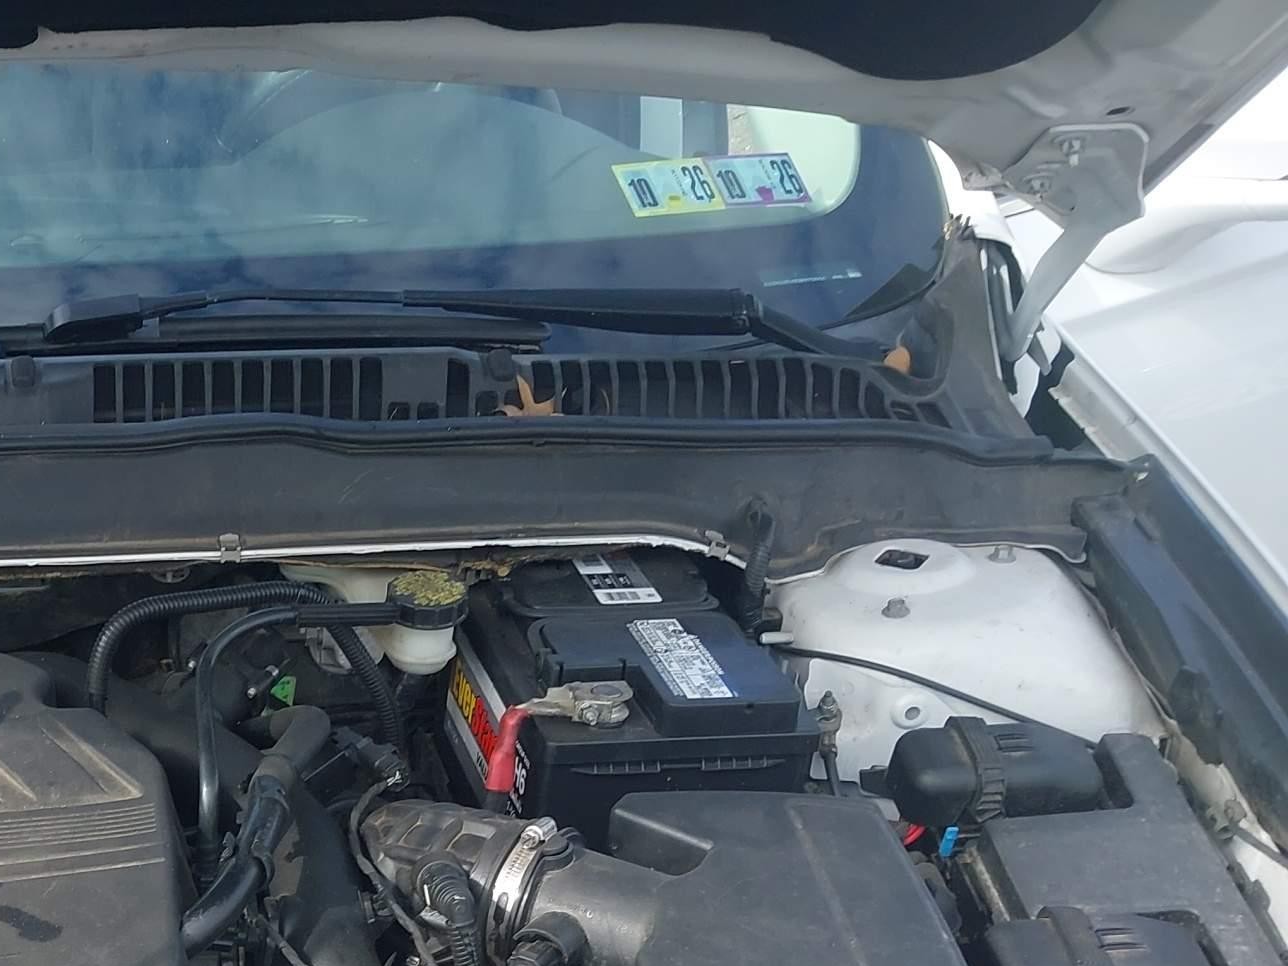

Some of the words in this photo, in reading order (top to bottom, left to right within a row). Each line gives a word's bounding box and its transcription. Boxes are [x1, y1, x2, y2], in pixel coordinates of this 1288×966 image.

[627, 178, 659, 208] 10
[681, 165, 715, 203] 26
[716, 169, 747, 200] 10
[769, 159, 804, 195] 26
[513, 756, 527, 796] H6
